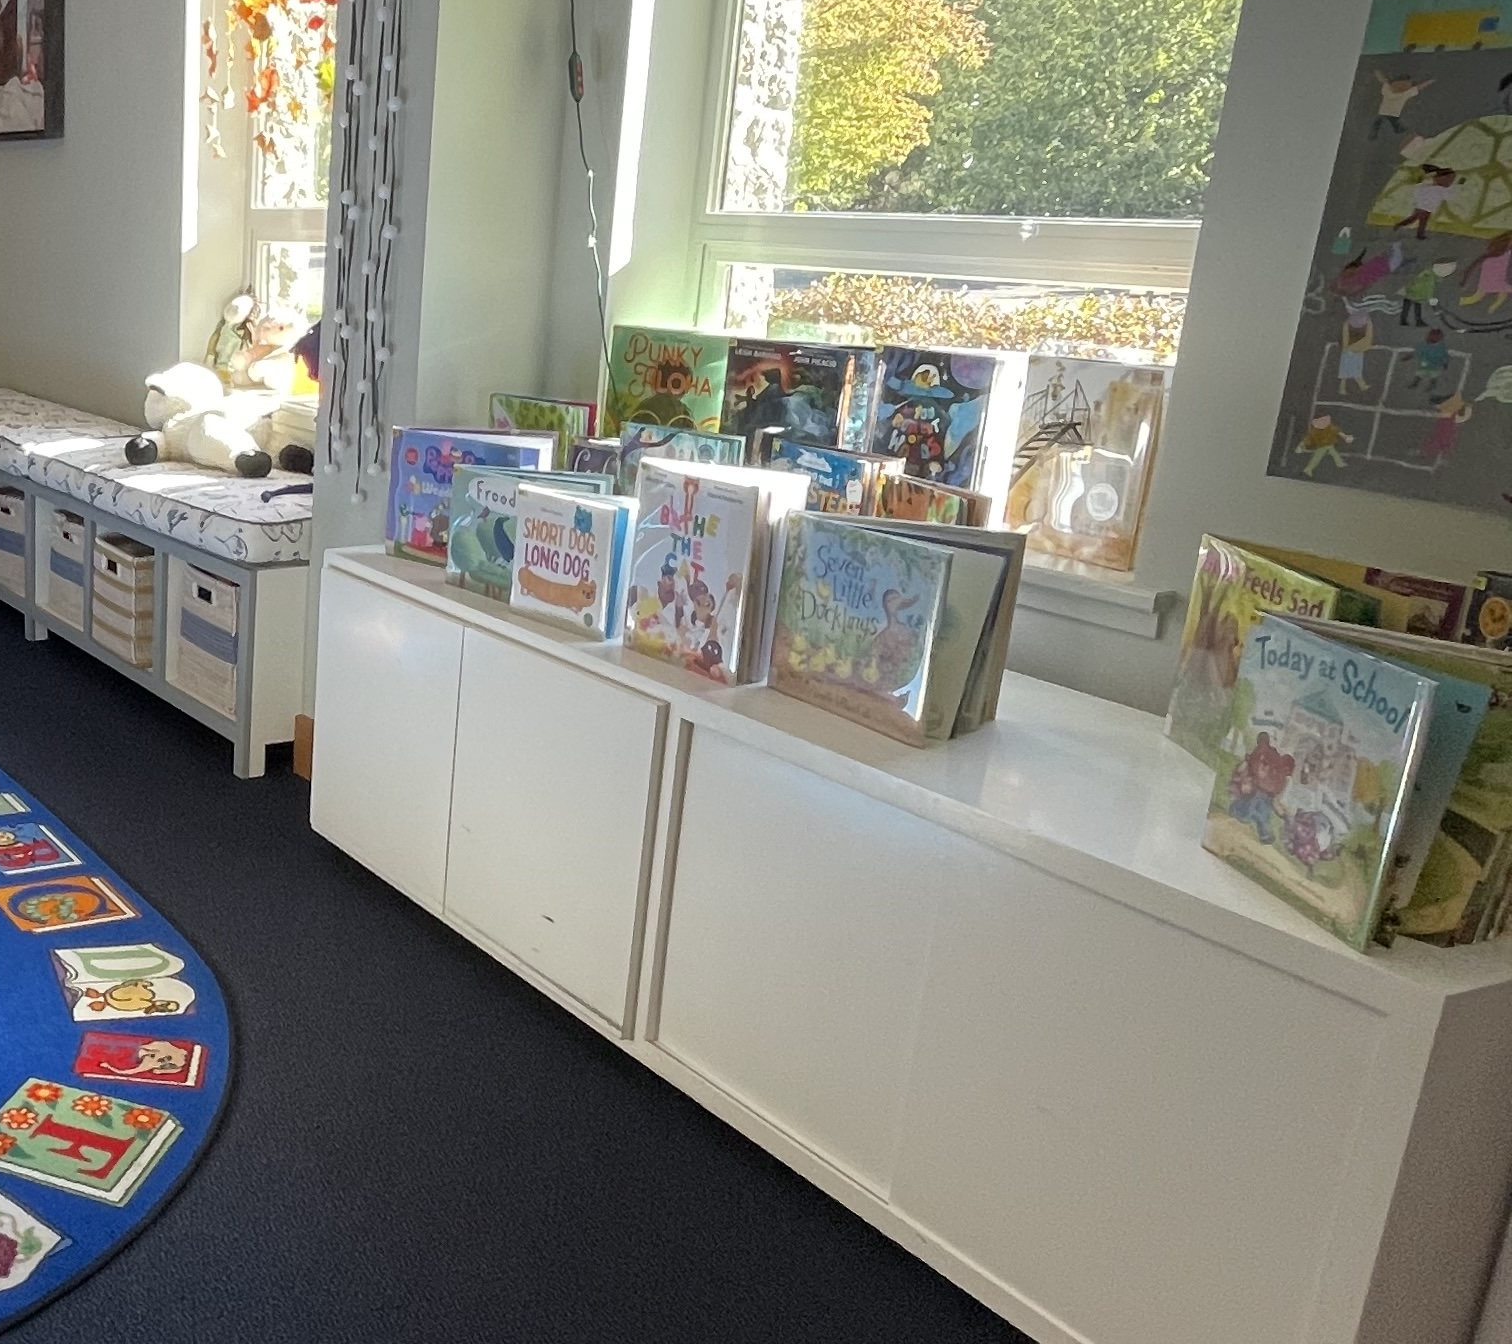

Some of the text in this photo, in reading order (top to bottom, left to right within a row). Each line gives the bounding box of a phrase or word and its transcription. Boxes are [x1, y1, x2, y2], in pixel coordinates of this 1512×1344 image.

[624, 332, 703, 367] PUNKY
[628, 361, 712, 398] ALOHA
[523, 516, 566, 547] SHORT
[524, 542, 590, 582] LONG DOG
[814, 544, 865, 582] Seven
[833, 575, 873, 609] Little
[1244, 565, 1285, 606] Feels
[801, 590, 880, 641] Ducklings
[1255, 635, 1411, 734] Today at School
[30, 1113, 137, 1180] F
